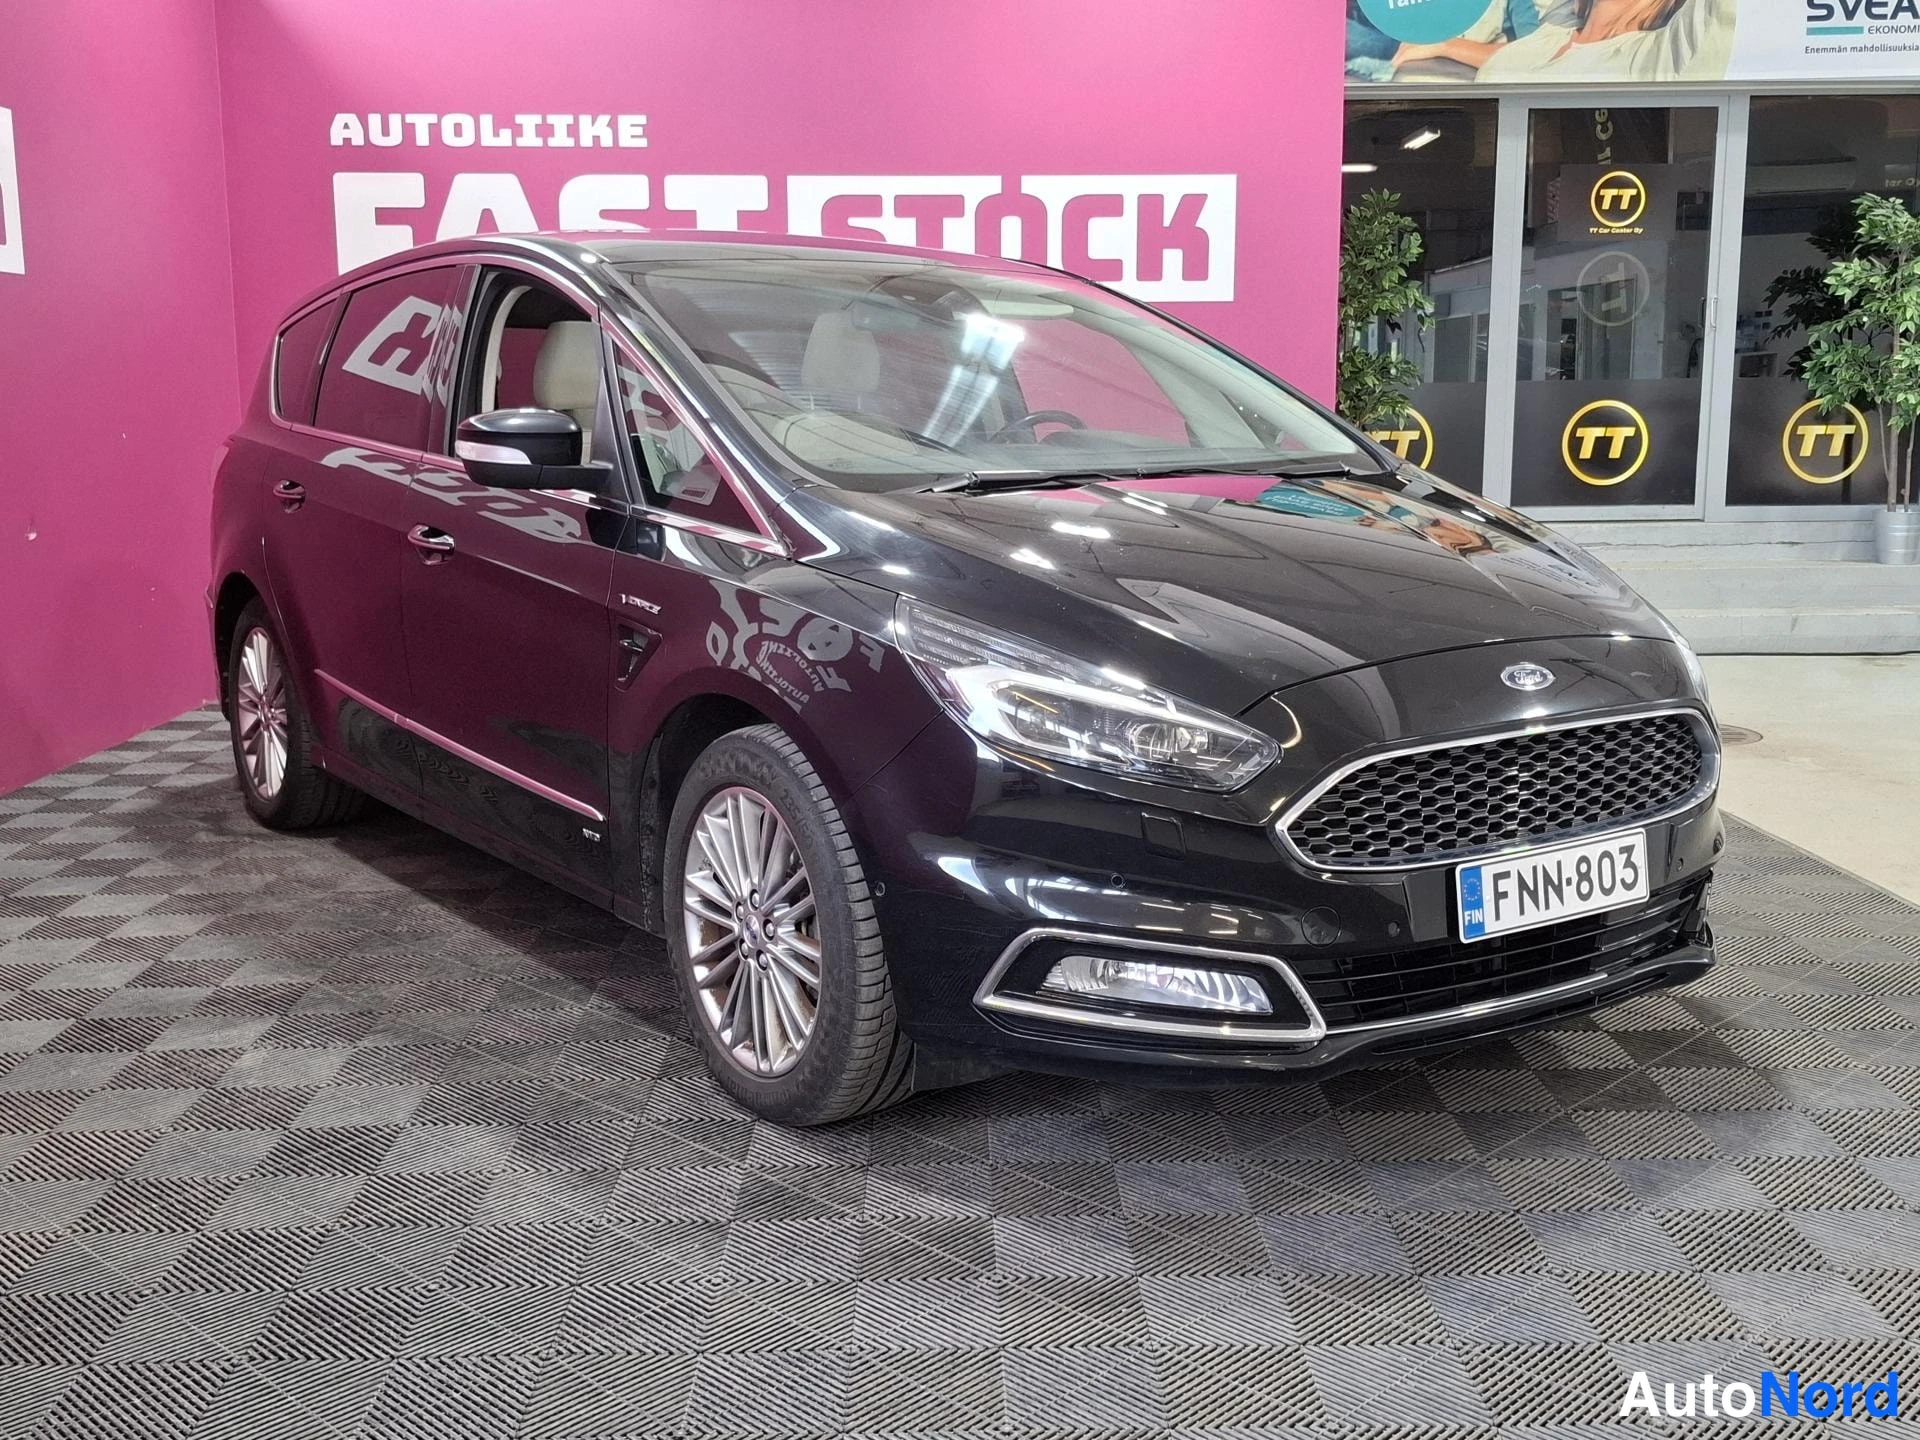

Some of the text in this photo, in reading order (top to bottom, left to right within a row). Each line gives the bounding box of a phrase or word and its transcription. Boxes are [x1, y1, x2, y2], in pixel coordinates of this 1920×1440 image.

[1806, 0, 1920, 22] SVEA
[1868, 25, 1920, 35] EKONOMI
[1805, 43, 1920, 54] Enemmän mahdollisuuksia
[330, 113, 648, 148] AUTOLIIKE
[1599, 188, 1638, 210] TT
[820, 193, 1210, 282] STOCK
[1576, 426, 1636, 459] TT
[1796, 424, 1856, 457] TT
[1492, 844, 1640, 922] FNN-803
[1464, 908, 1484, 926] FIN
